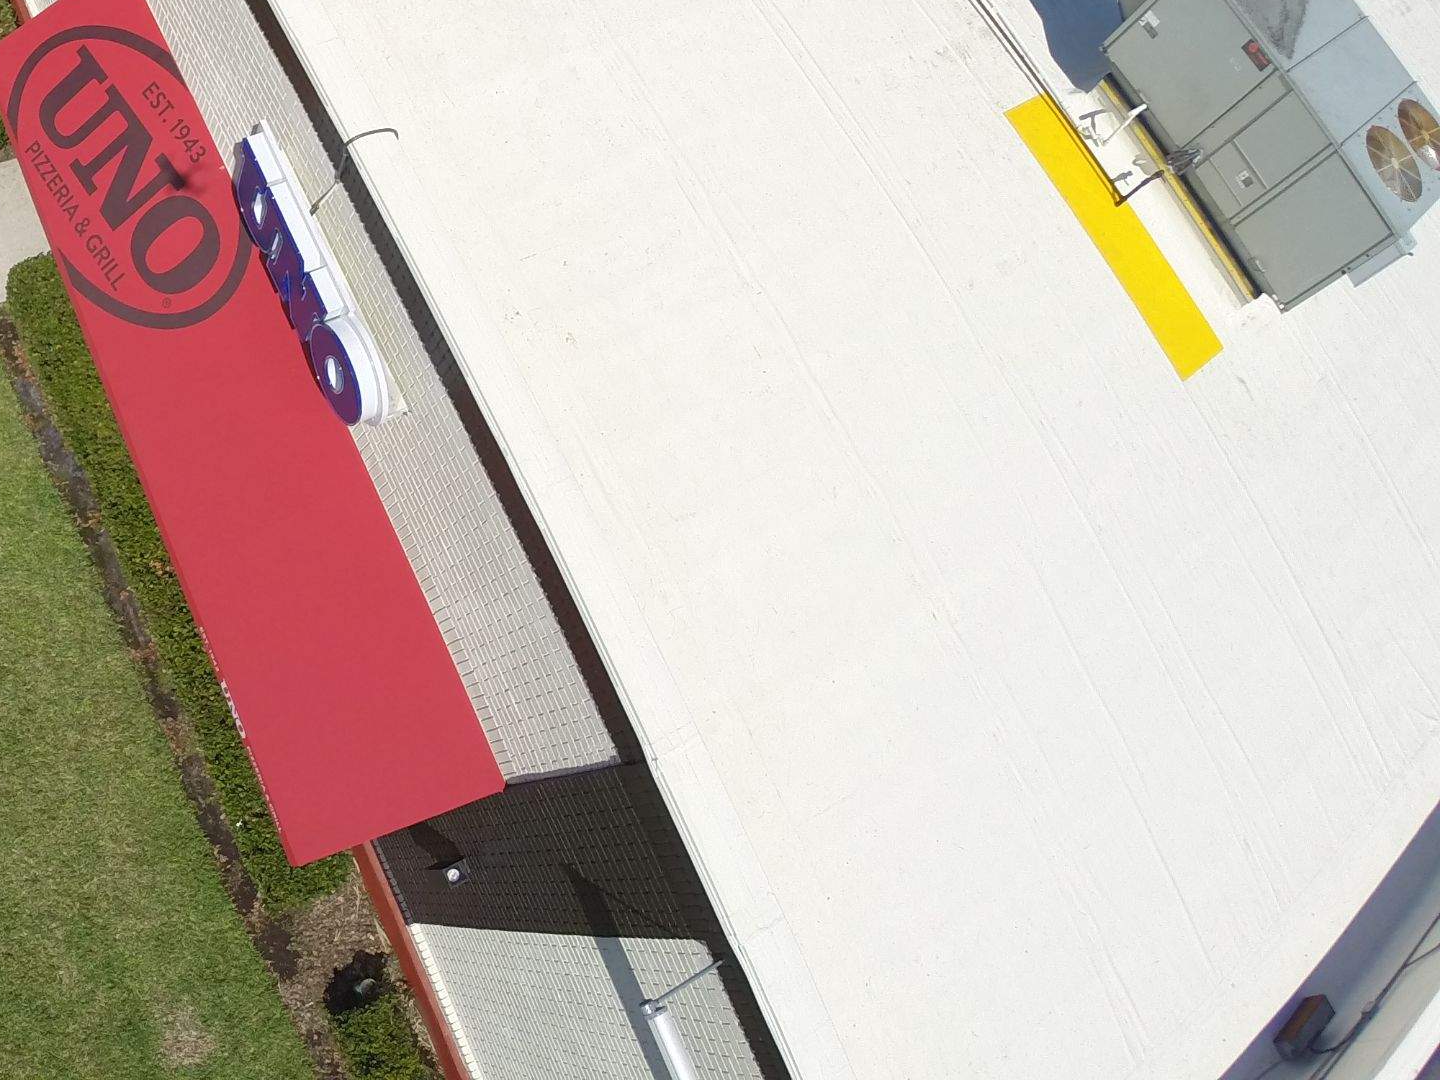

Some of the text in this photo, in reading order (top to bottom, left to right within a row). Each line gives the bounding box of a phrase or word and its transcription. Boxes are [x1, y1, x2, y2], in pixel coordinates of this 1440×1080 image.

[39, 44, 221, 295] UNO
[142, 81, 207, 164] EST. 1943
[24, 139, 125, 292] PIZZERIA & GRILL
[233, 134, 368, 427] UNO
[220, 678, 247, 739] UNO
